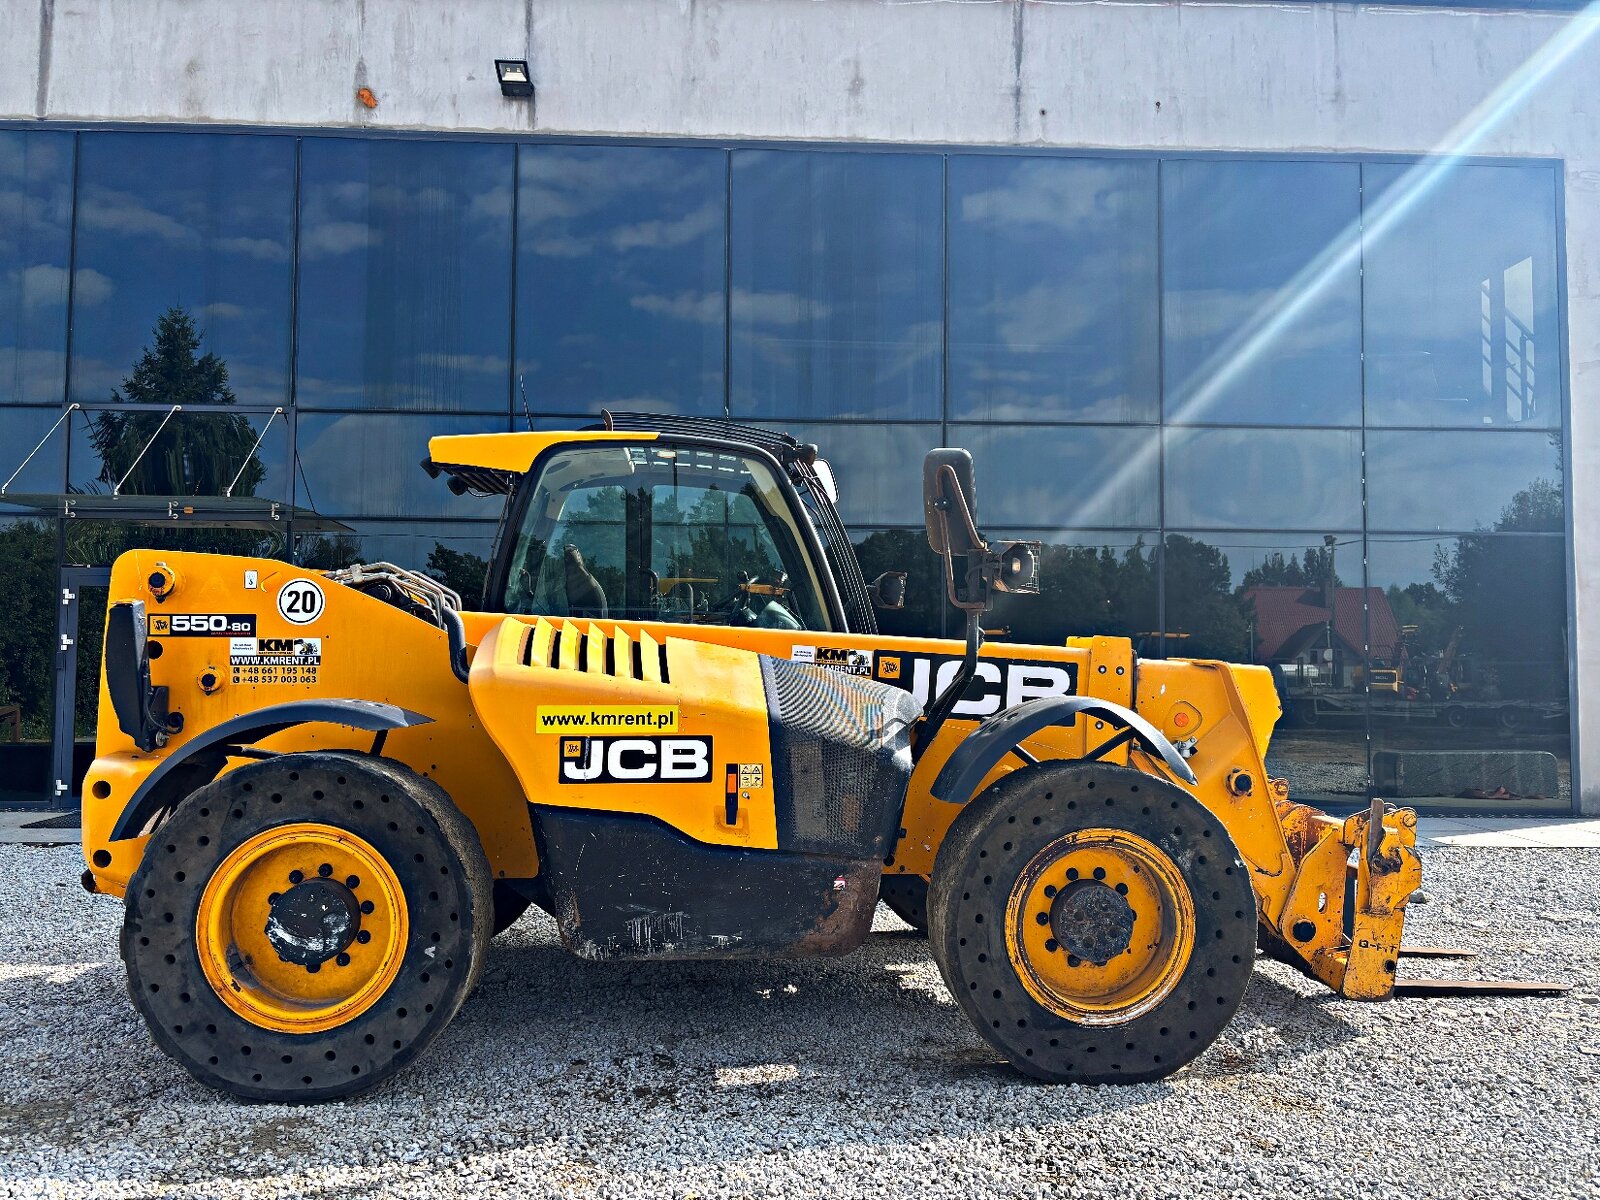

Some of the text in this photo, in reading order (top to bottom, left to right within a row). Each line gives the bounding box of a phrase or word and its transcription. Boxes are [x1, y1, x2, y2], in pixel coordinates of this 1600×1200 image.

[286, 590, 316, 613] 20
[171, 615, 251, 631] 550-80
[258, 639, 293, 651] KM
[230, 656, 320, 665] WWW.KMRENT.PL
[816, 647, 848, 661] KM
[911, 658, 1071, 714] JCB
[541, 711, 674, 729] www.kmrent.pl
[563, 739, 709, 780] JCB
